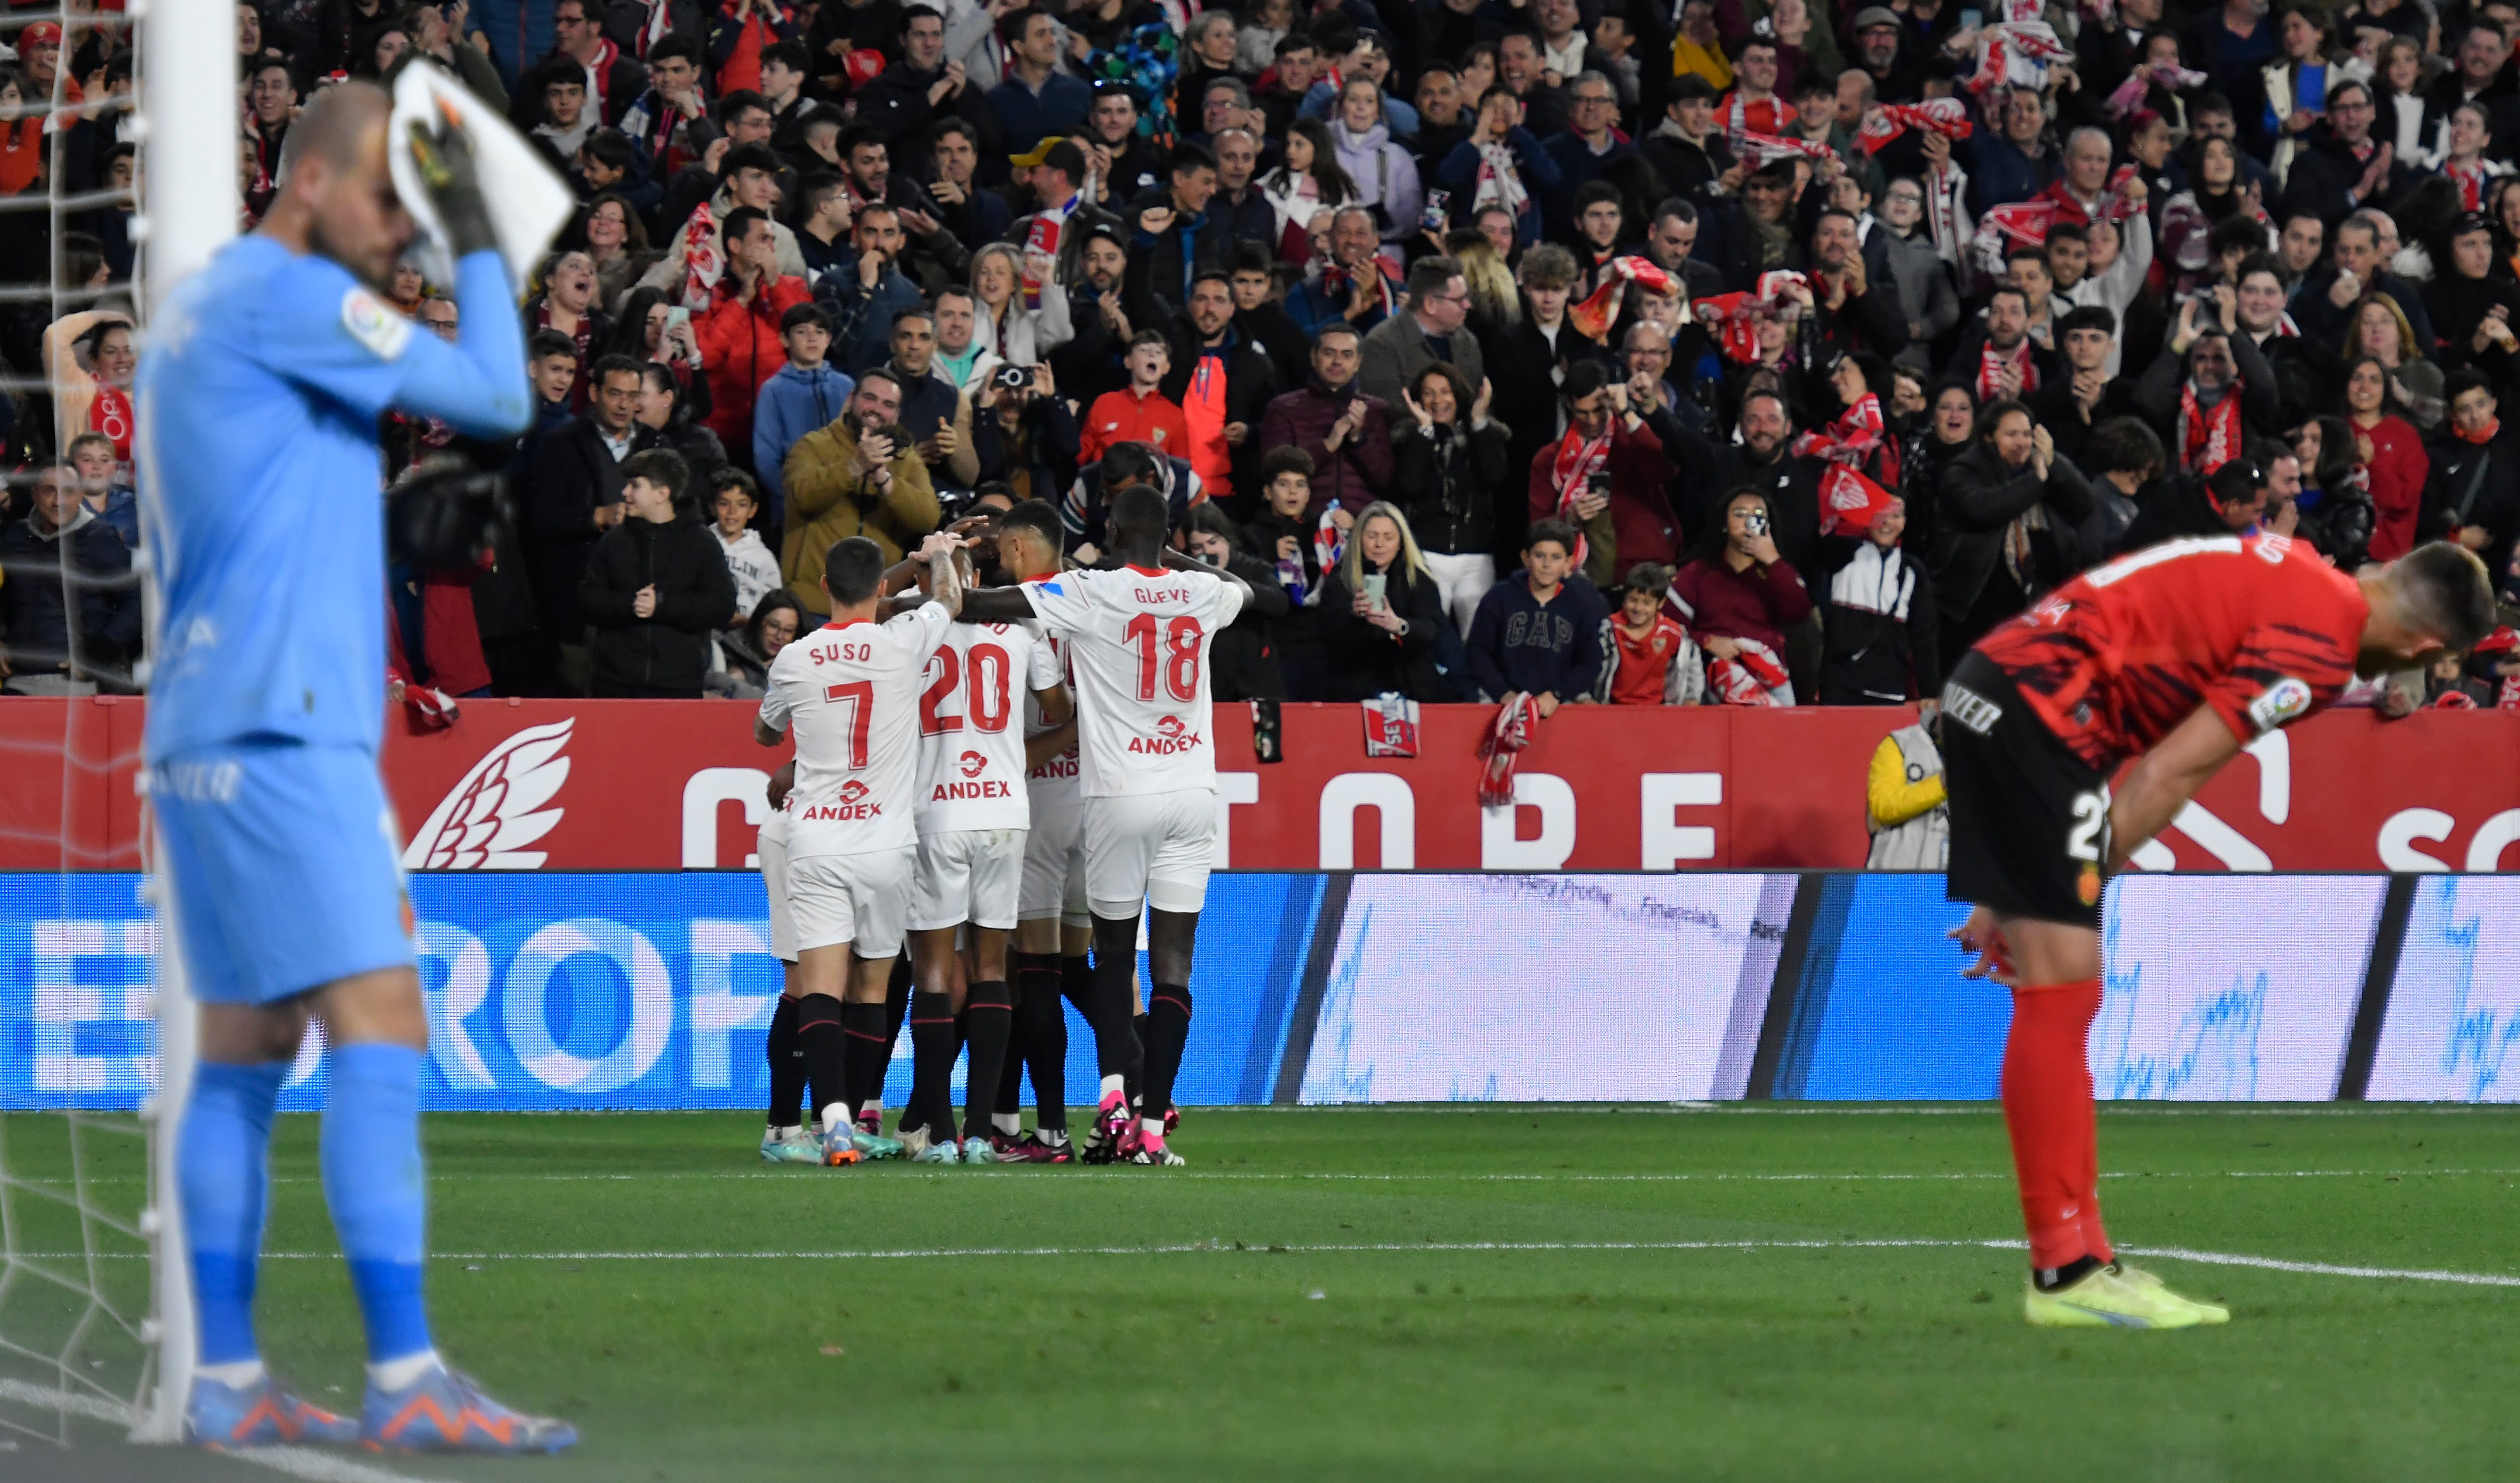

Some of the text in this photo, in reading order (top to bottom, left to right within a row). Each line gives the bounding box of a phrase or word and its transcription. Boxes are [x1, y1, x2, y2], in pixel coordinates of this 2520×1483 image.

[1505, 611, 1573, 654] GAP
[809, 643, 871, 665] SUSO
[1122, 613, 1204, 703] 18
[919, 643, 1011, 737] 20
[824, 680, 873, 771] 7
[1128, 732, 1202, 755] ANDEX
[1032, 761, 1080, 779] AND
[932, 781, 1012, 801] ANDEX
[803, 802, 882, 821] ANDEX
[2068, 794, 2111, 862] 2
